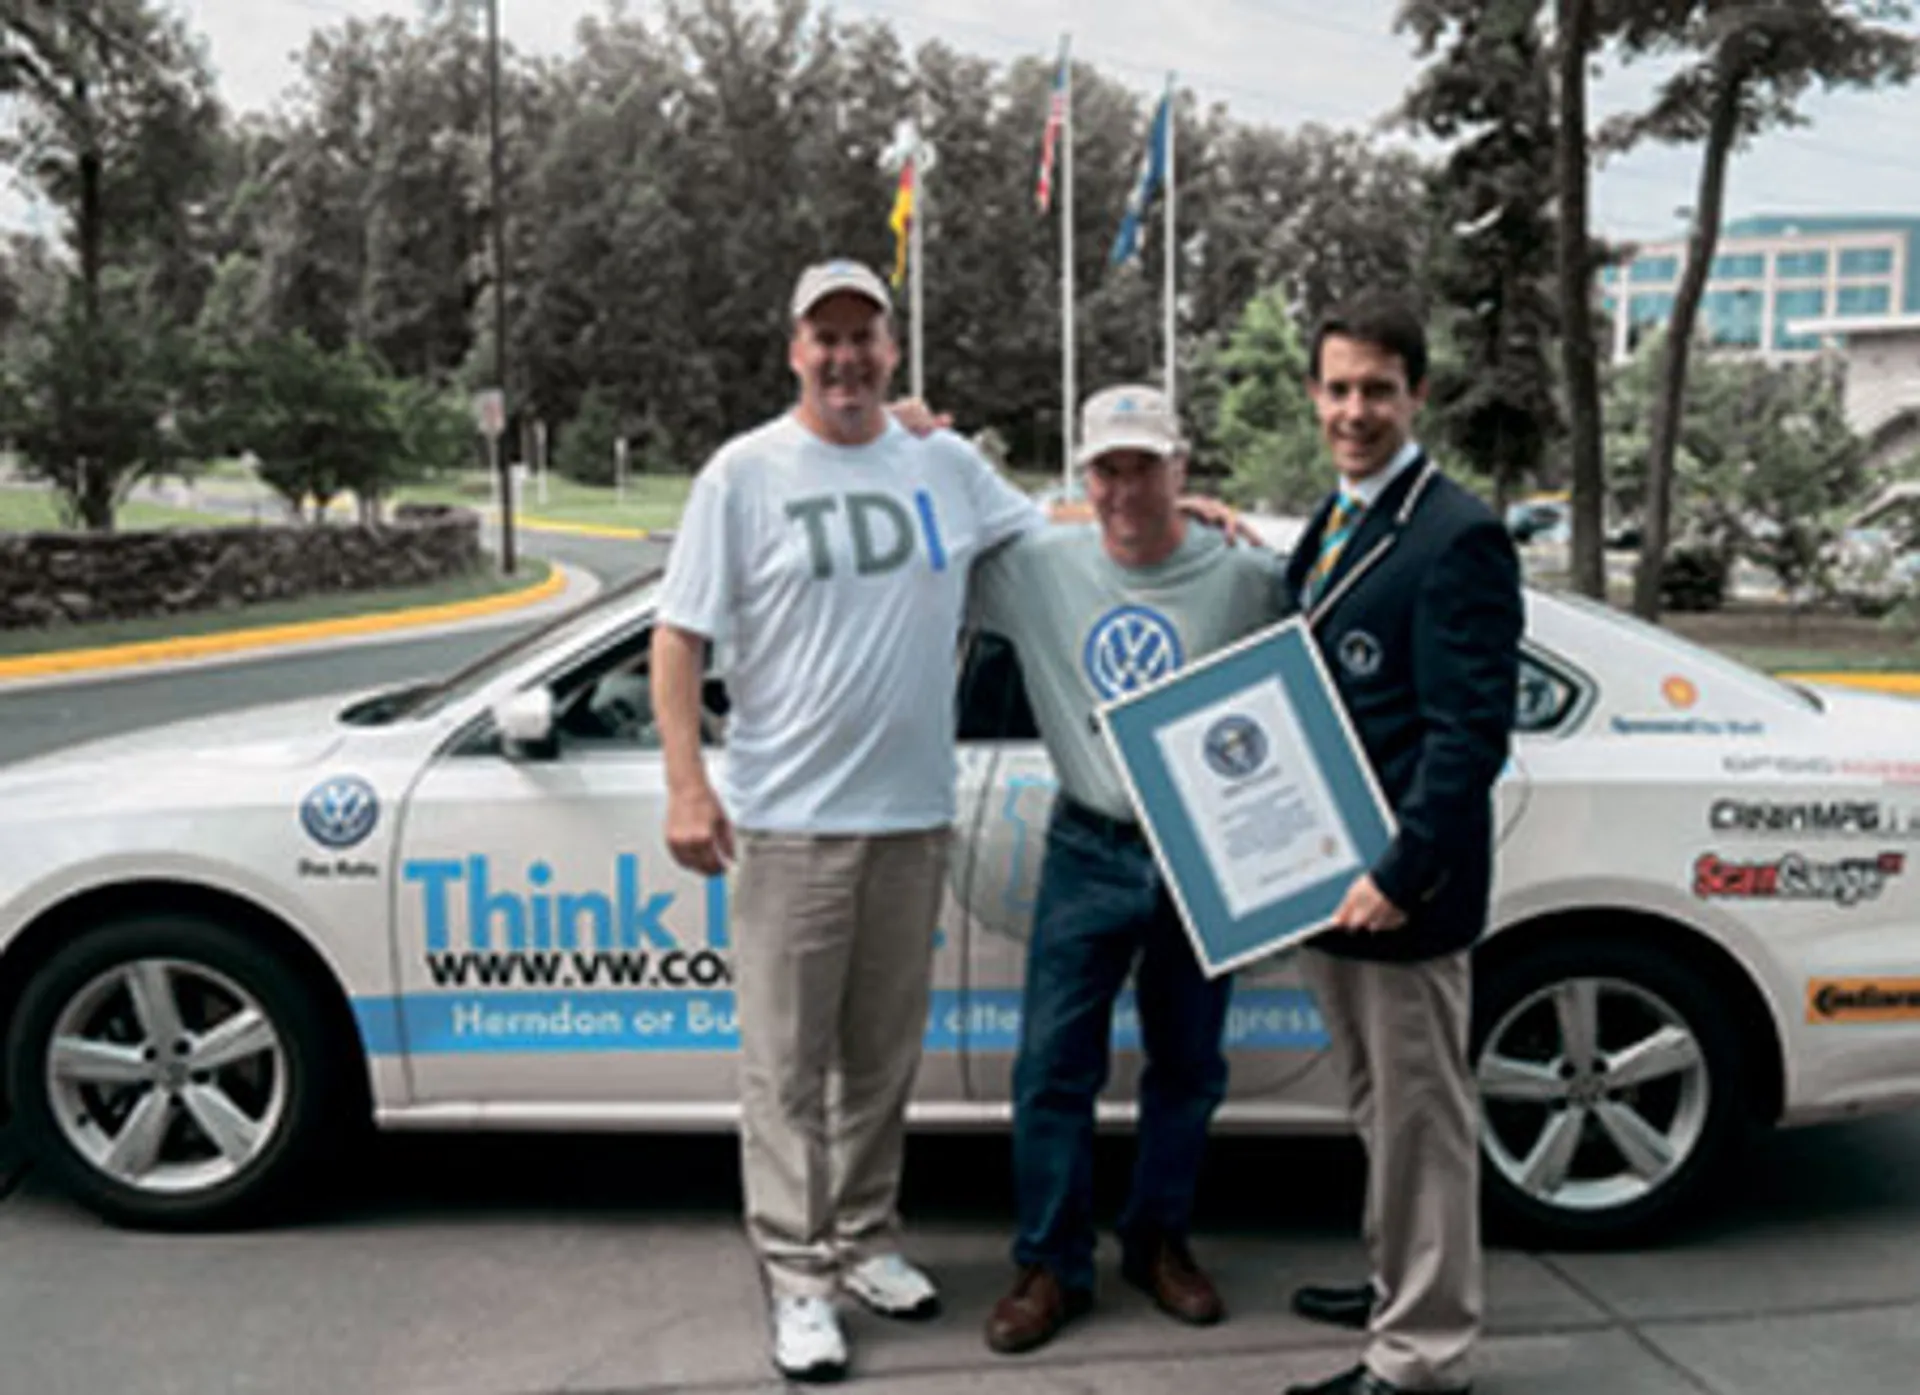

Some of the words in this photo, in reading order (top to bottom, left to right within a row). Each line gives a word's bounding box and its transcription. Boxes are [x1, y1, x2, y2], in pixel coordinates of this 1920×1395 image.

[785, 490, 946, 579] TDI
[404, 854, 676, 949] Think
[426, 952, 733, 986] www.vw.co
[452, 1003, 622, 1034] Herndon
[633, 1011, 675, 1033] or
[686, 1001, 738, 1034] Bu
